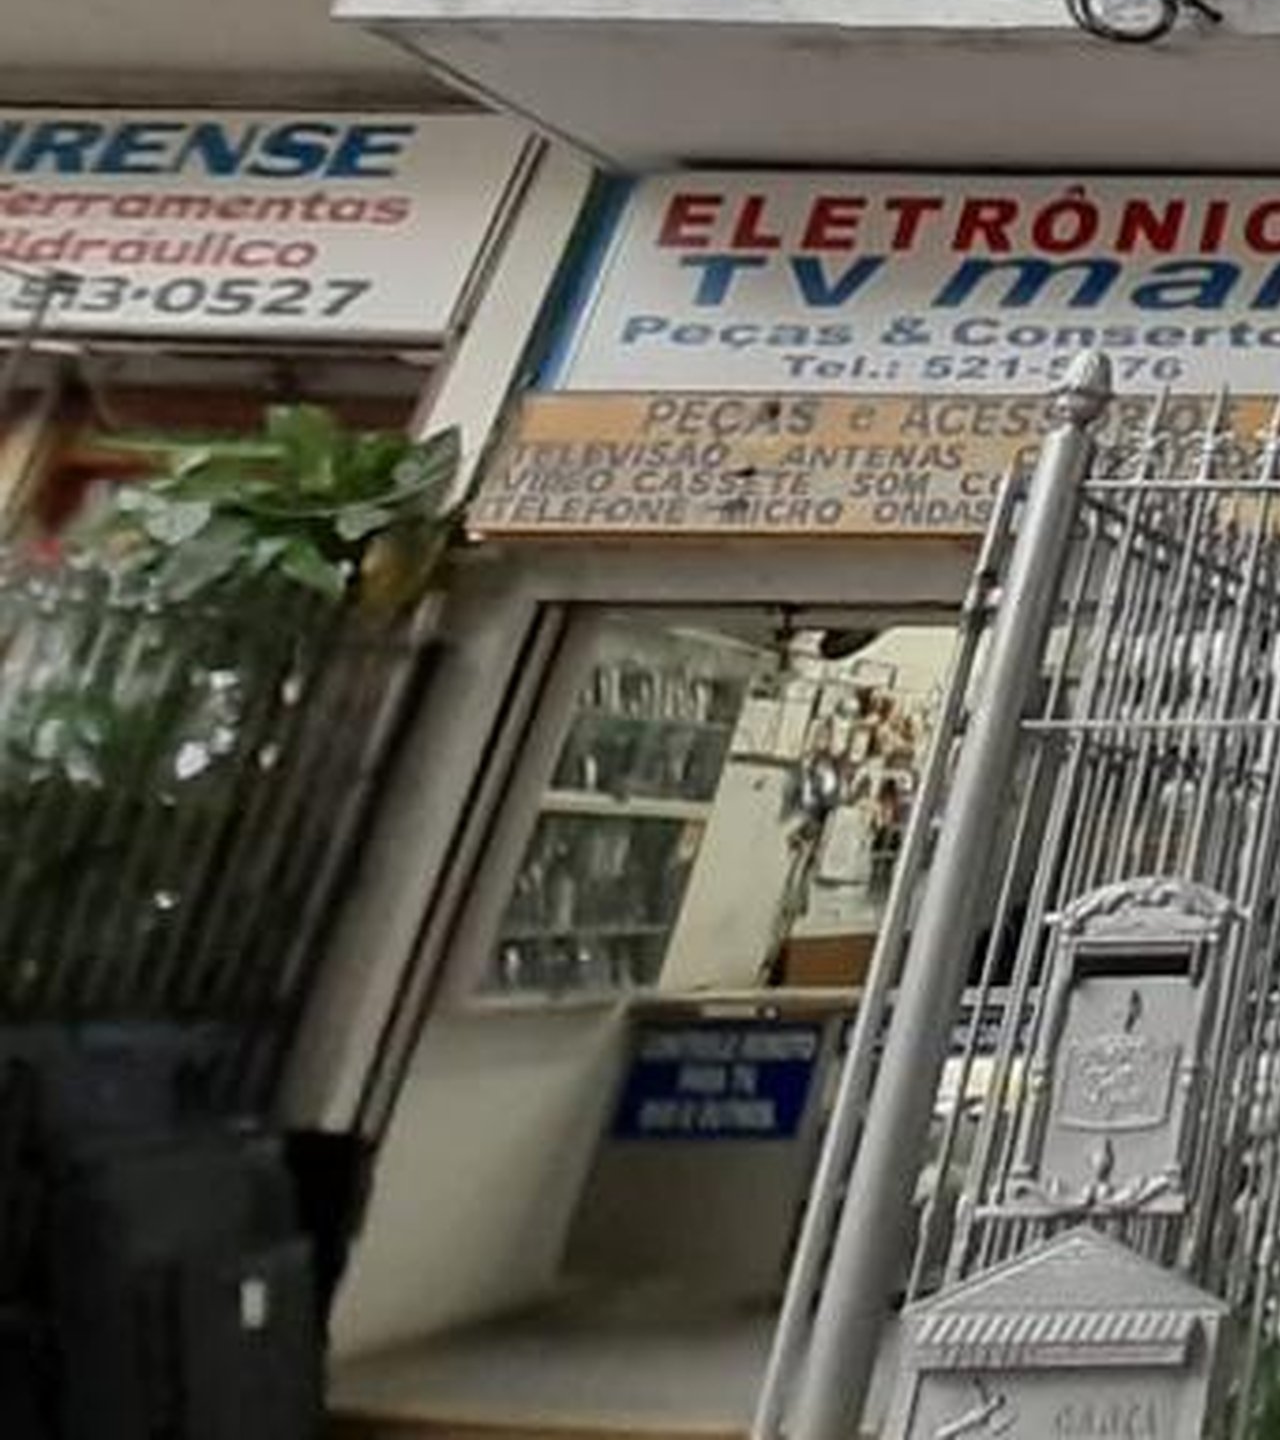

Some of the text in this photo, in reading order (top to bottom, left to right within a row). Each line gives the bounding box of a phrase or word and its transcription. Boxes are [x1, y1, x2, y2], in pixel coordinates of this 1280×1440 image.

[679, 255, 886, 307] TV
[619, 316, 853, 348] Peças
[880, 317, 930, 346] &
[781, 355, 1184, 381] Tel.: 521-576
